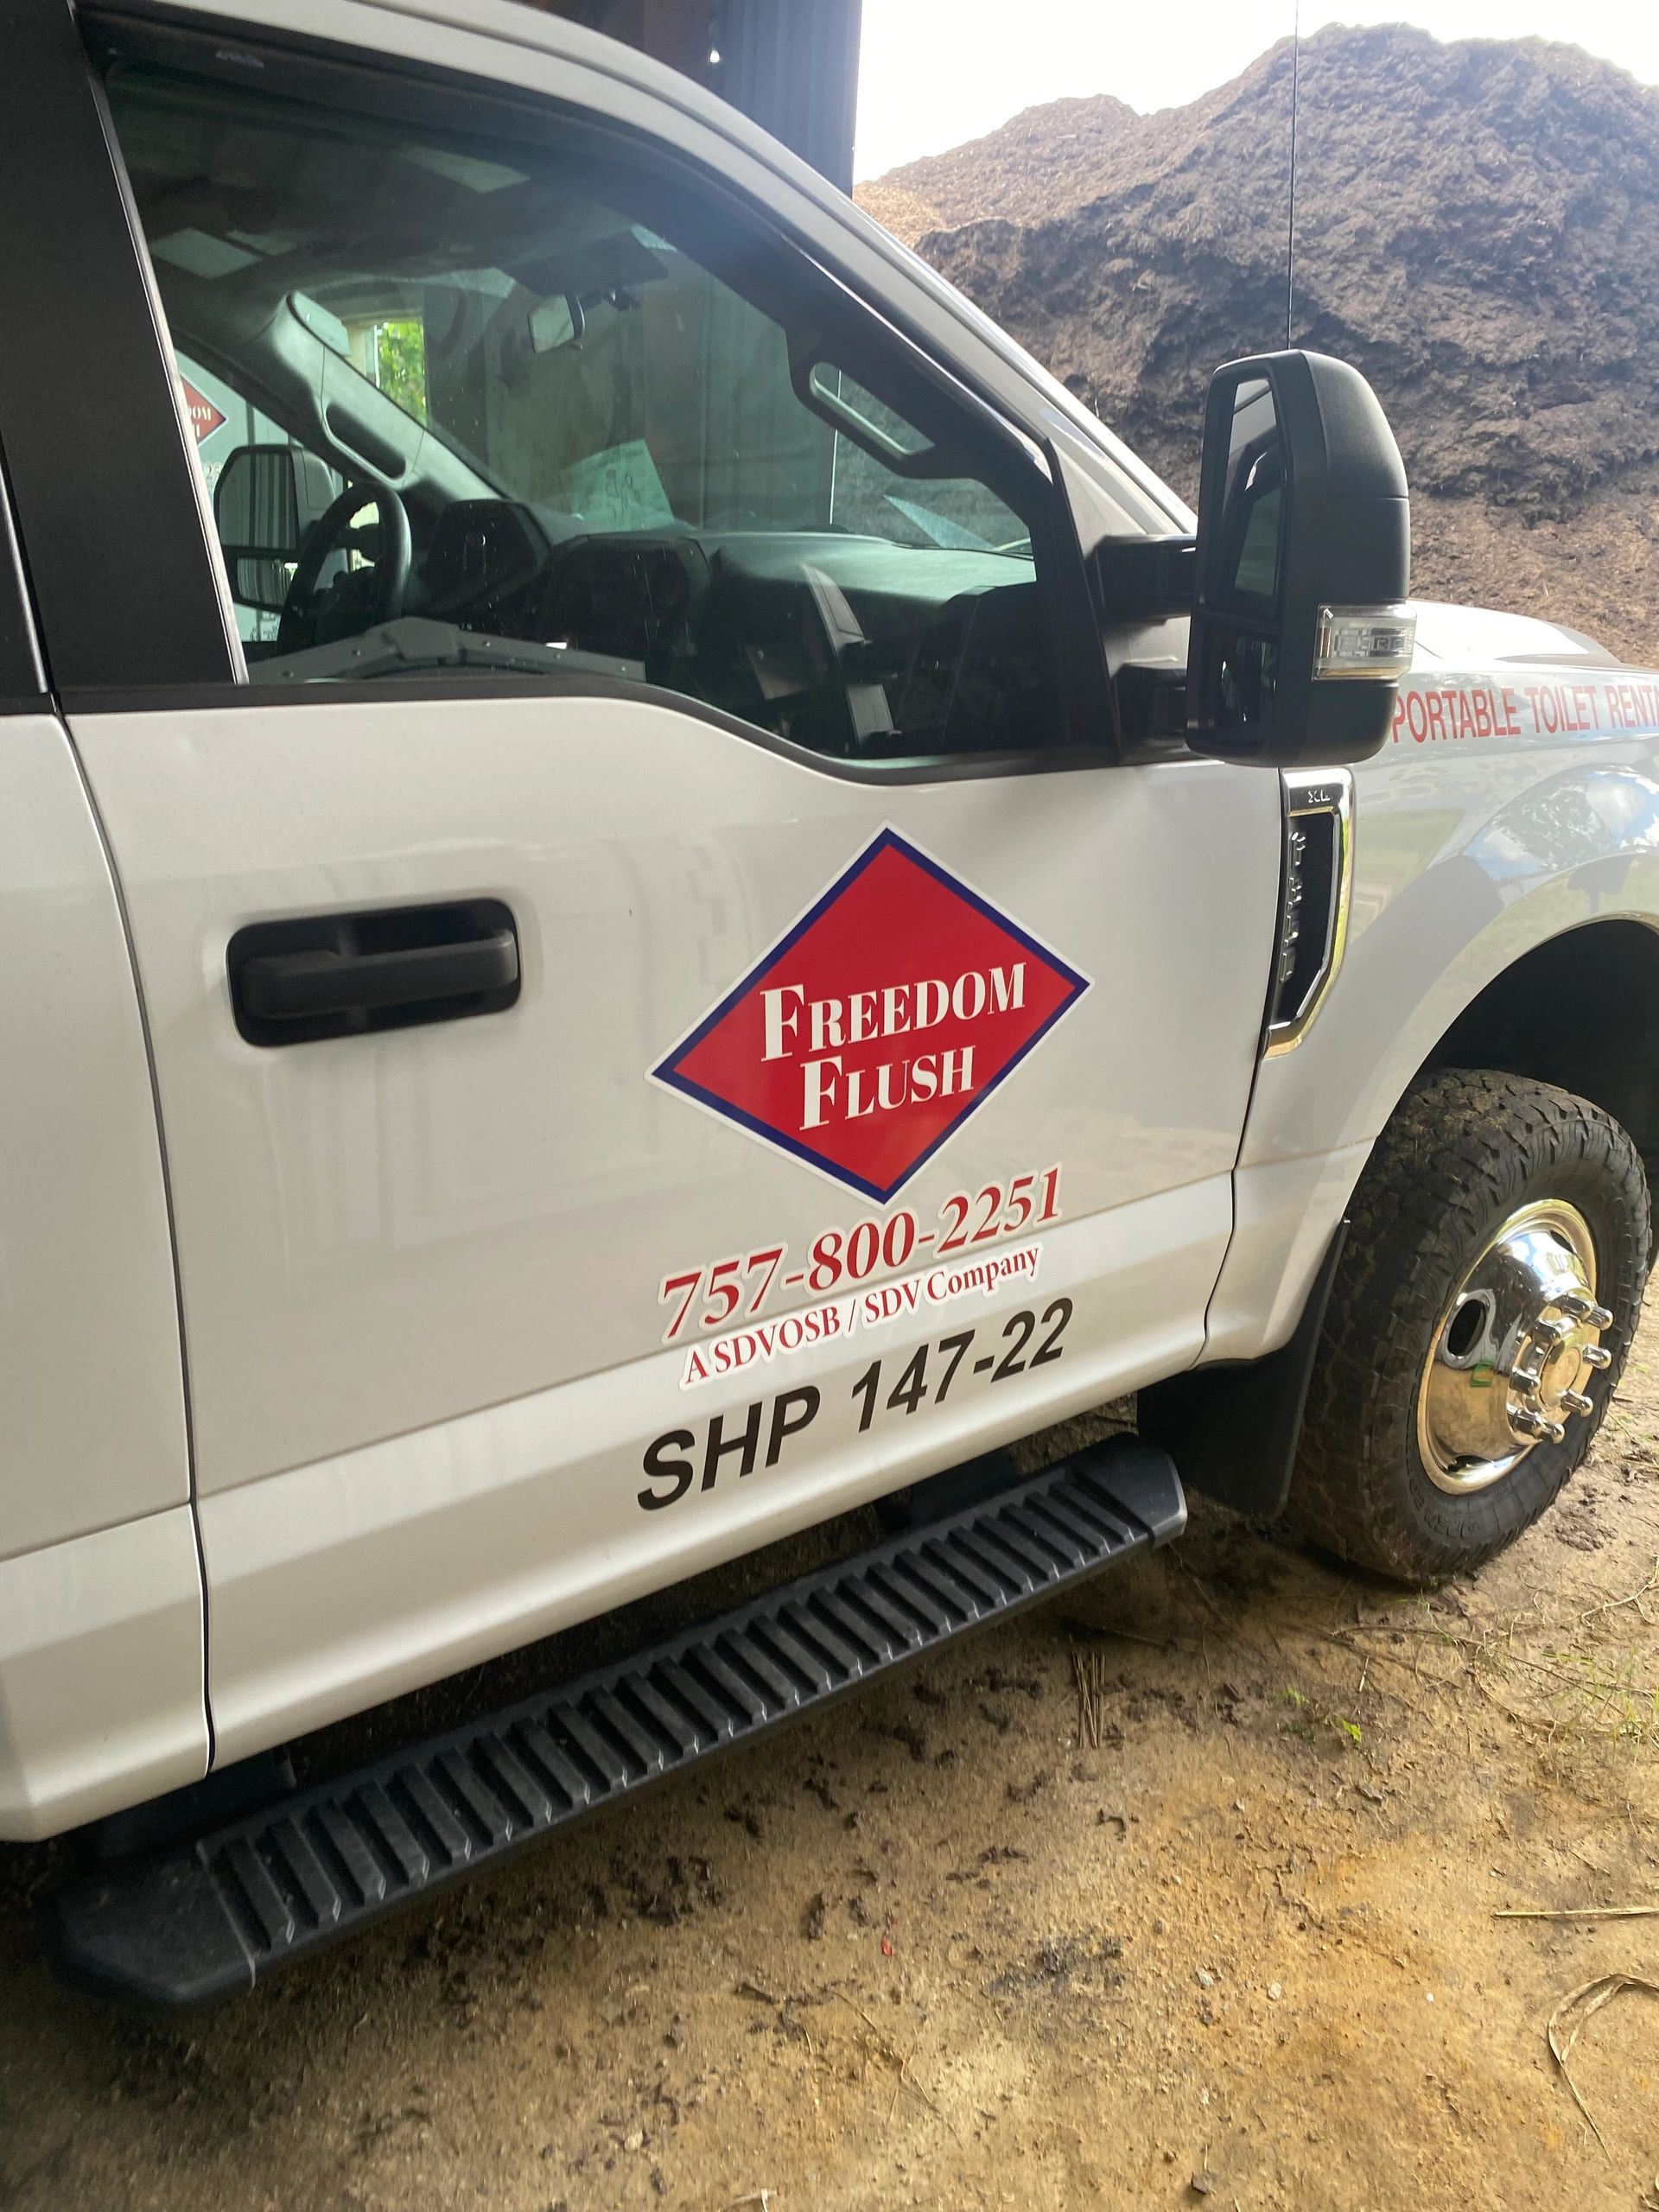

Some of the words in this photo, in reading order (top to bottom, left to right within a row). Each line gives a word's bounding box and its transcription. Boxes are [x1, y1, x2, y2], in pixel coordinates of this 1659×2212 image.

[1392, 688, 1521, 743] PORTABLE
[1524, 685, 1599, 734] TOILET
[1307, 788, 1331, 804] XL
[760, 962, 1027, 1062] FREEDOM
[798, 1046, 976, 1130] FLUSH
[663, 1166, 1061, 1340] 757-800-2251
[685, 1350, 711, 1384] A
[715, 1306, 841, 1373] SDVOSB
[865, 1279, 922, 1325] SDV
[927, 1247, 1039, 1301] Company
[636, 1385, 822, 1512] SHP
[851, 1297, 1073, 1433] 147-22
